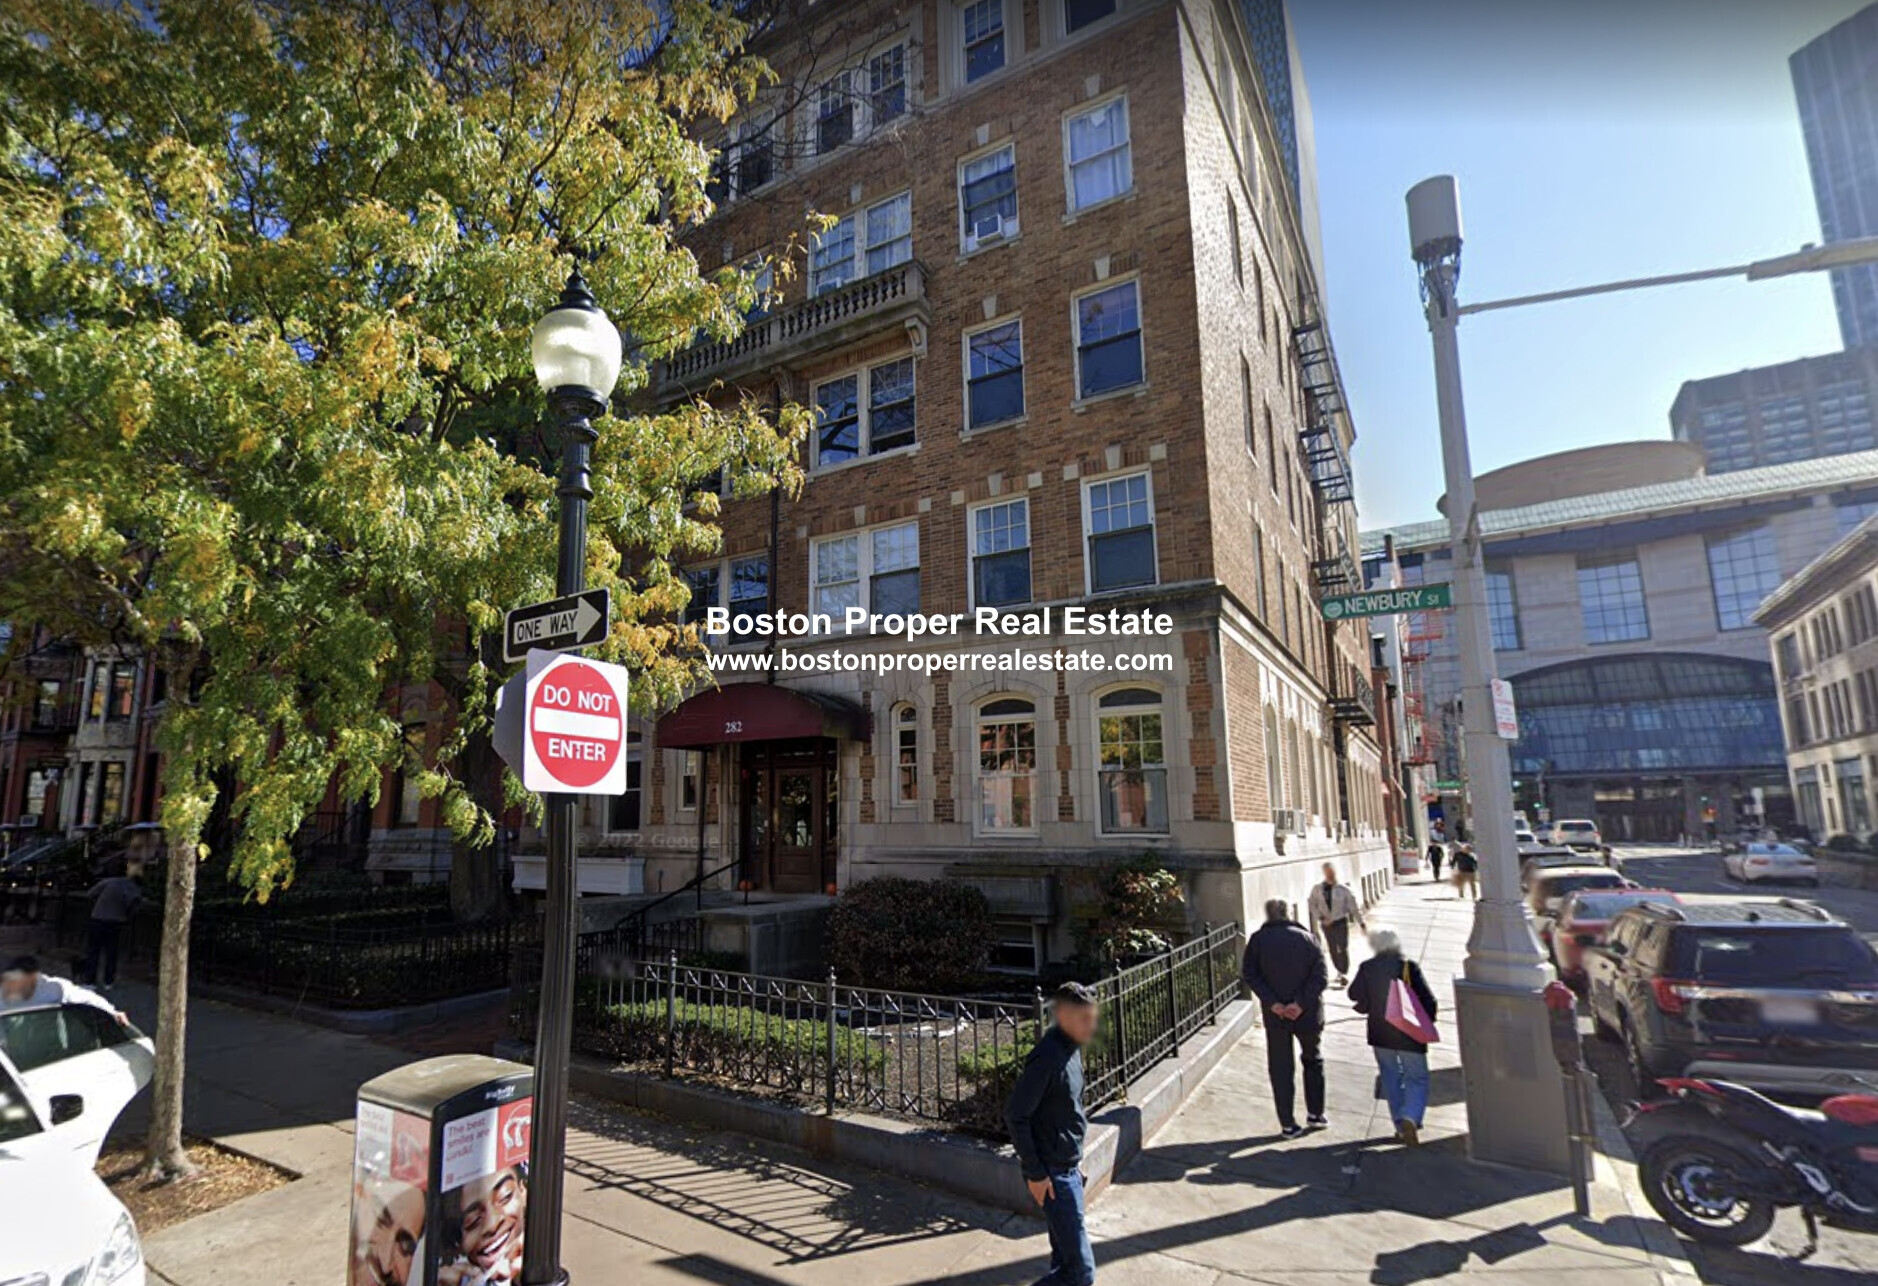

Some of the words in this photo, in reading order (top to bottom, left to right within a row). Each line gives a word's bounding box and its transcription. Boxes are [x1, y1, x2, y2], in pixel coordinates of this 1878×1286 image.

[1345, 590, 1423, 614] NEWBURY
[517, 619, 542, 641] ONE
[550, 610, 578, 635] WAY
[543, 684, 571, 707] DO
[577, 690, 613, 713] NOT
[725, 720, 743, 733] 282
[548, 738, 606, 762] ENTER
